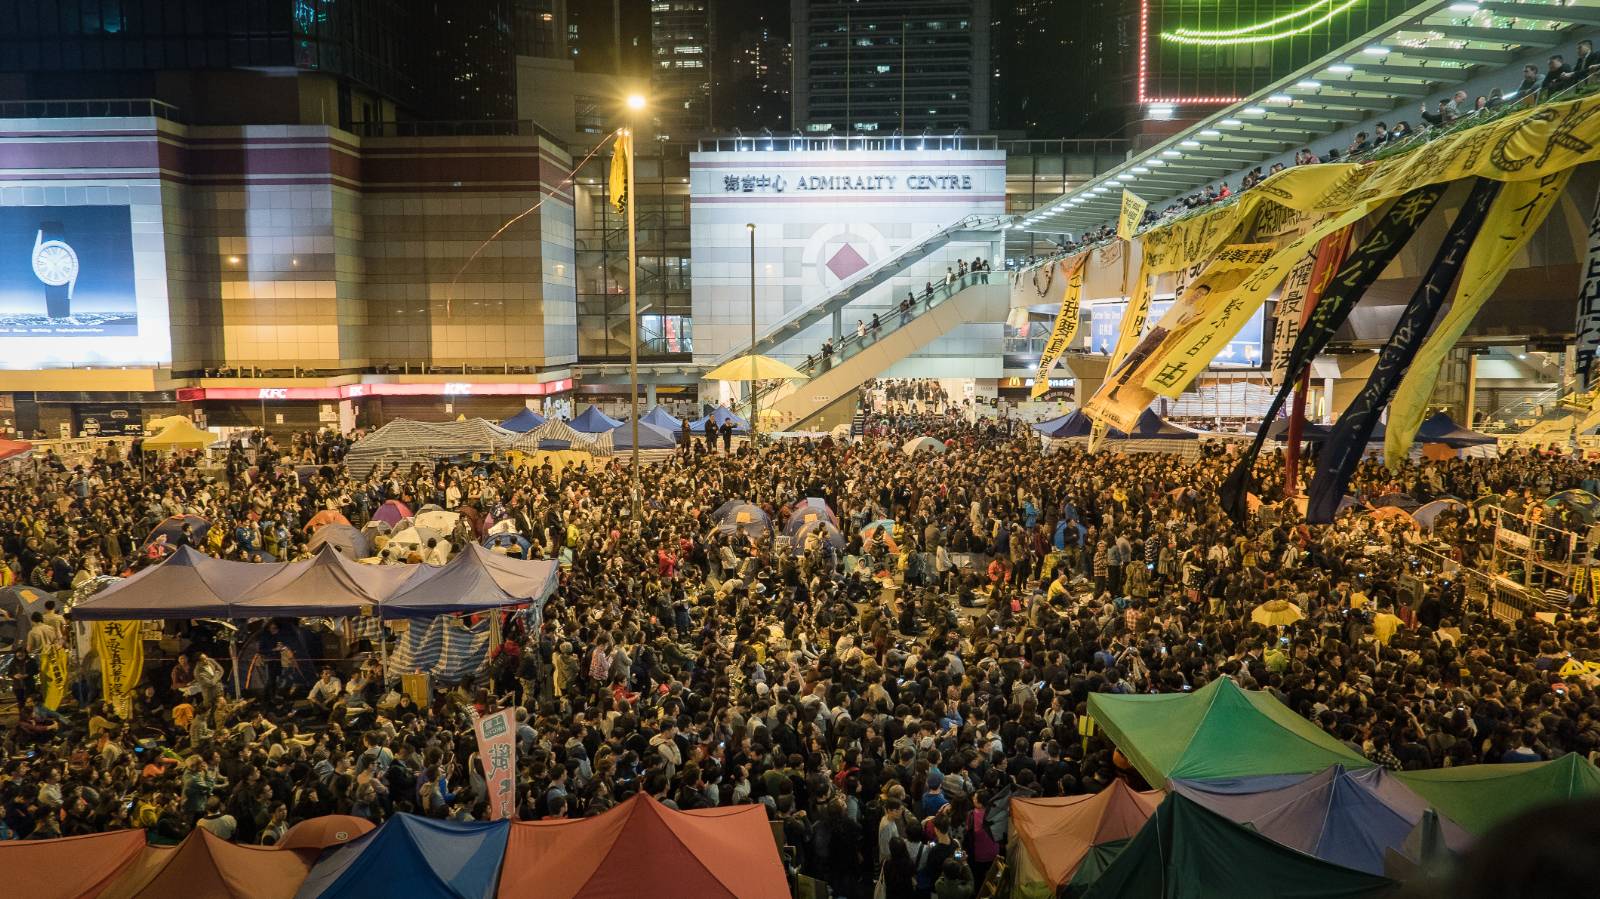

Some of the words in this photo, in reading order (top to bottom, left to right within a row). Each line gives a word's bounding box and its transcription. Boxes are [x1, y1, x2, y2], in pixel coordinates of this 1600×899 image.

[724, 174, 787, 193] 海富中心
[797, 175, 896, 190] ADMIRALTY
[906, 174, 972, 190] CENTRE
[258, 388, 288, 398] KFC
